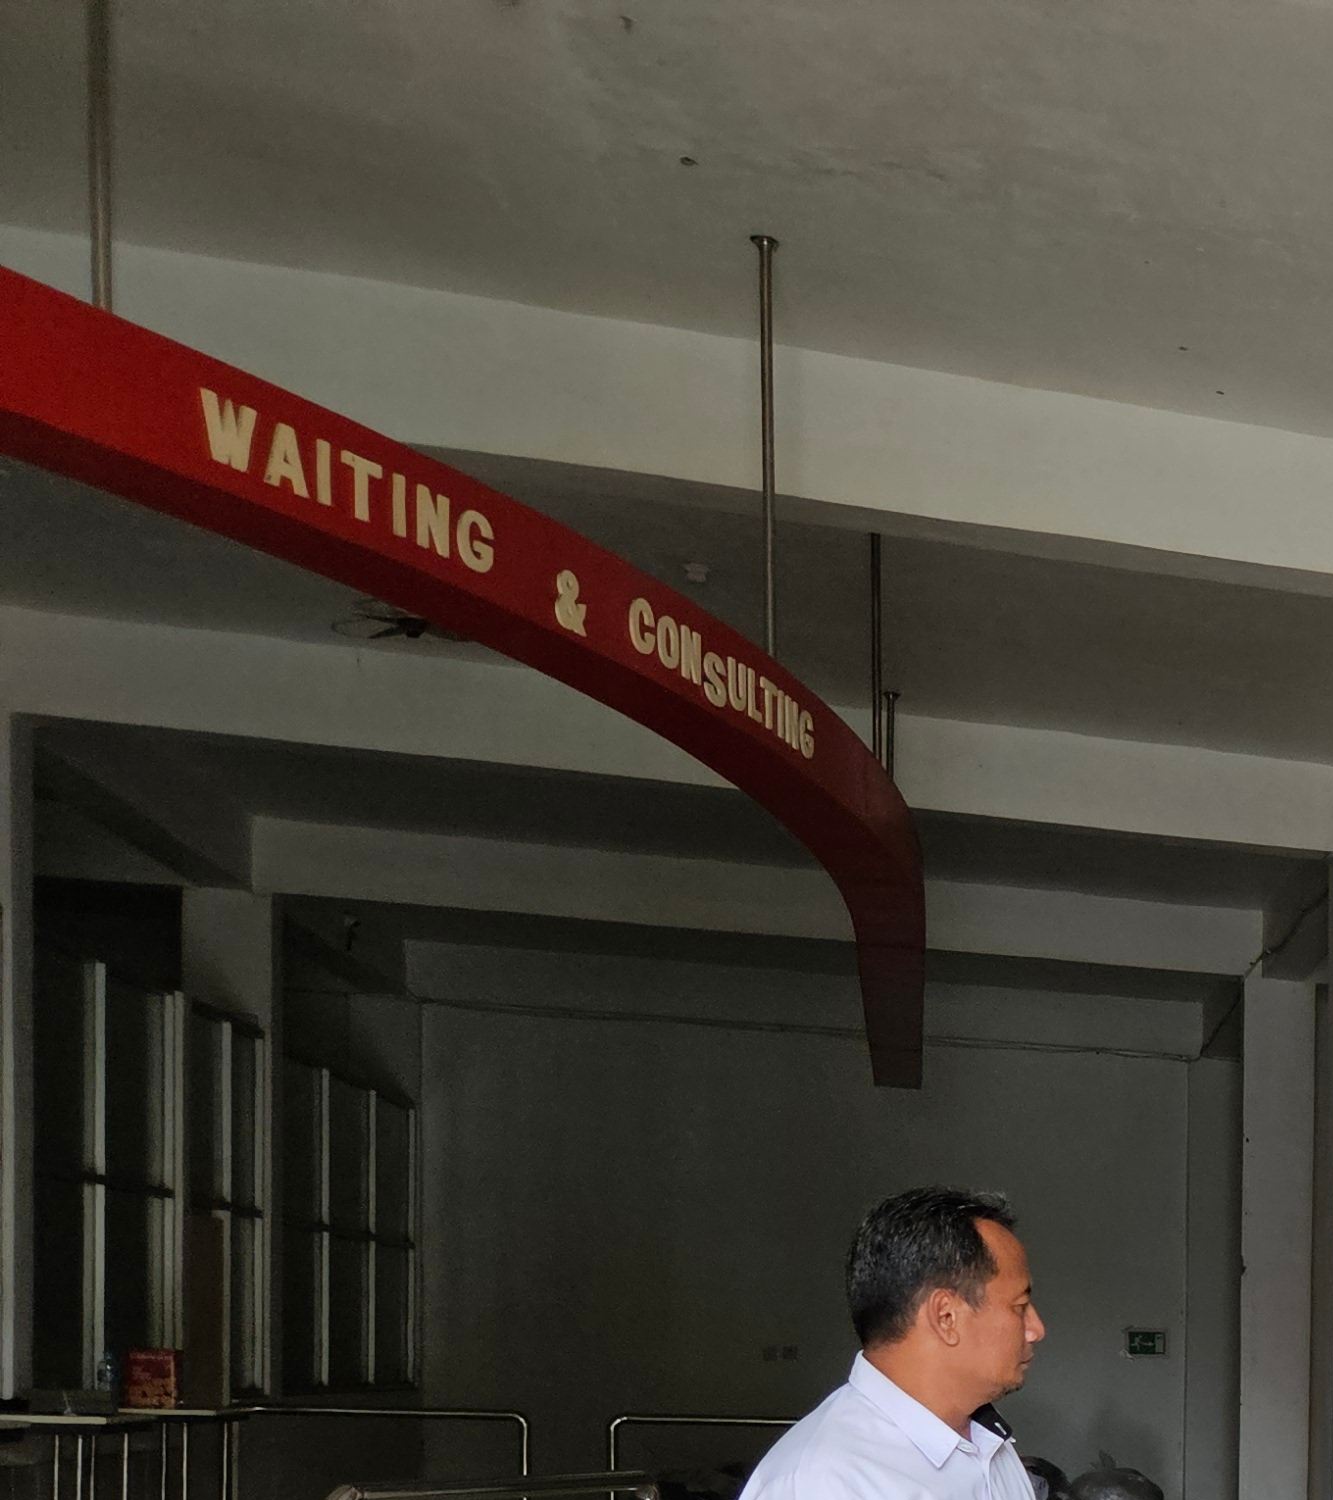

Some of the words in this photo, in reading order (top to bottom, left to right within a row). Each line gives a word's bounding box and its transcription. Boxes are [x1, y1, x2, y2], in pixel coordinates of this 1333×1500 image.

[200, 388, 495, 573] WAITING
[555, 570, 587, 637] &
[629, 598, 814, 758] CONSULTING
